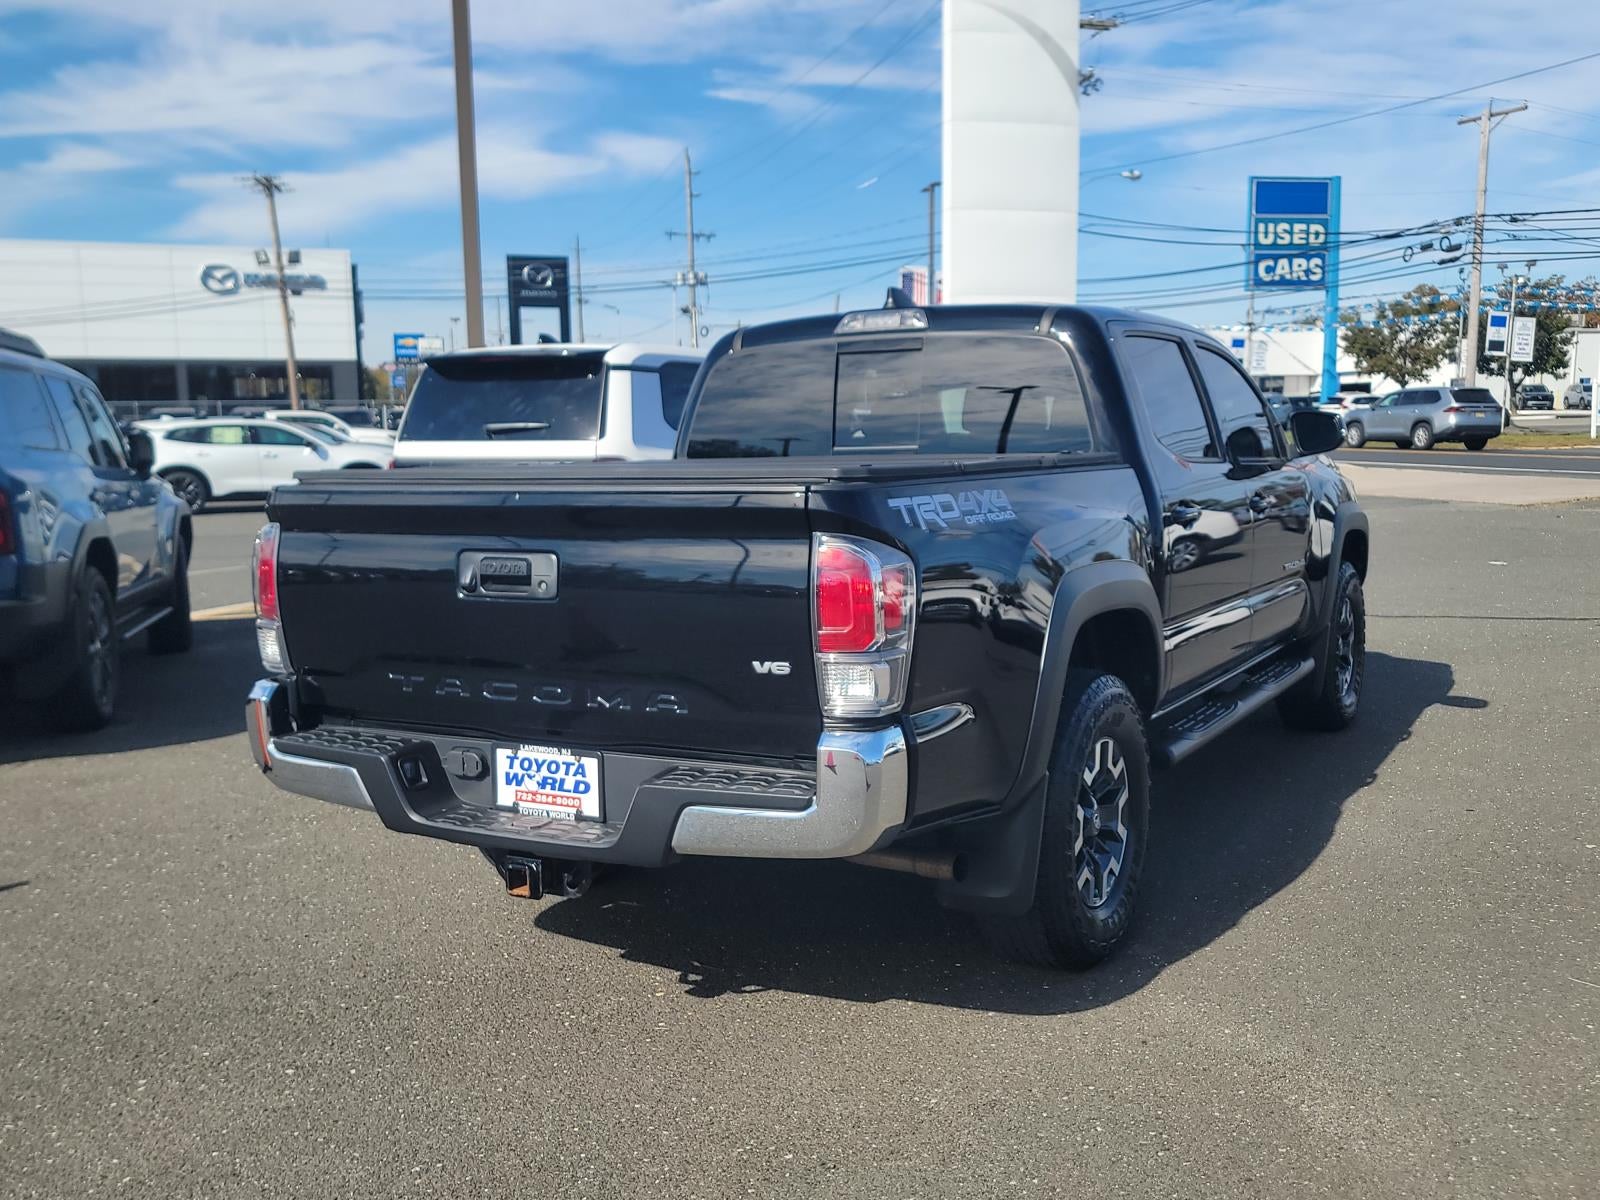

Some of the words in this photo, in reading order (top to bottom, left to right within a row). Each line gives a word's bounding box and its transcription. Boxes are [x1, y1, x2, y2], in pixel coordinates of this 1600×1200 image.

[1258, 222, 1326, 246] USED
[1258, 257, 1323, 282] CARS
[887, 493, 962, 532] TRD
[964, 513, 986, 525] OFF
[988, 510, 1017, 522] ROAD
[752, 661, 791, 675] V6
[388, 672, 689, 714] TACOMA
[520, 743, 560, 755] LAKEWOOD,
[562, 747, 571, 756] NJ
[506, 754, 587, 778] TOYOTA
[519, 807, 547, 818] TOYOTA
[549, 810, 575, 821] WORLD
